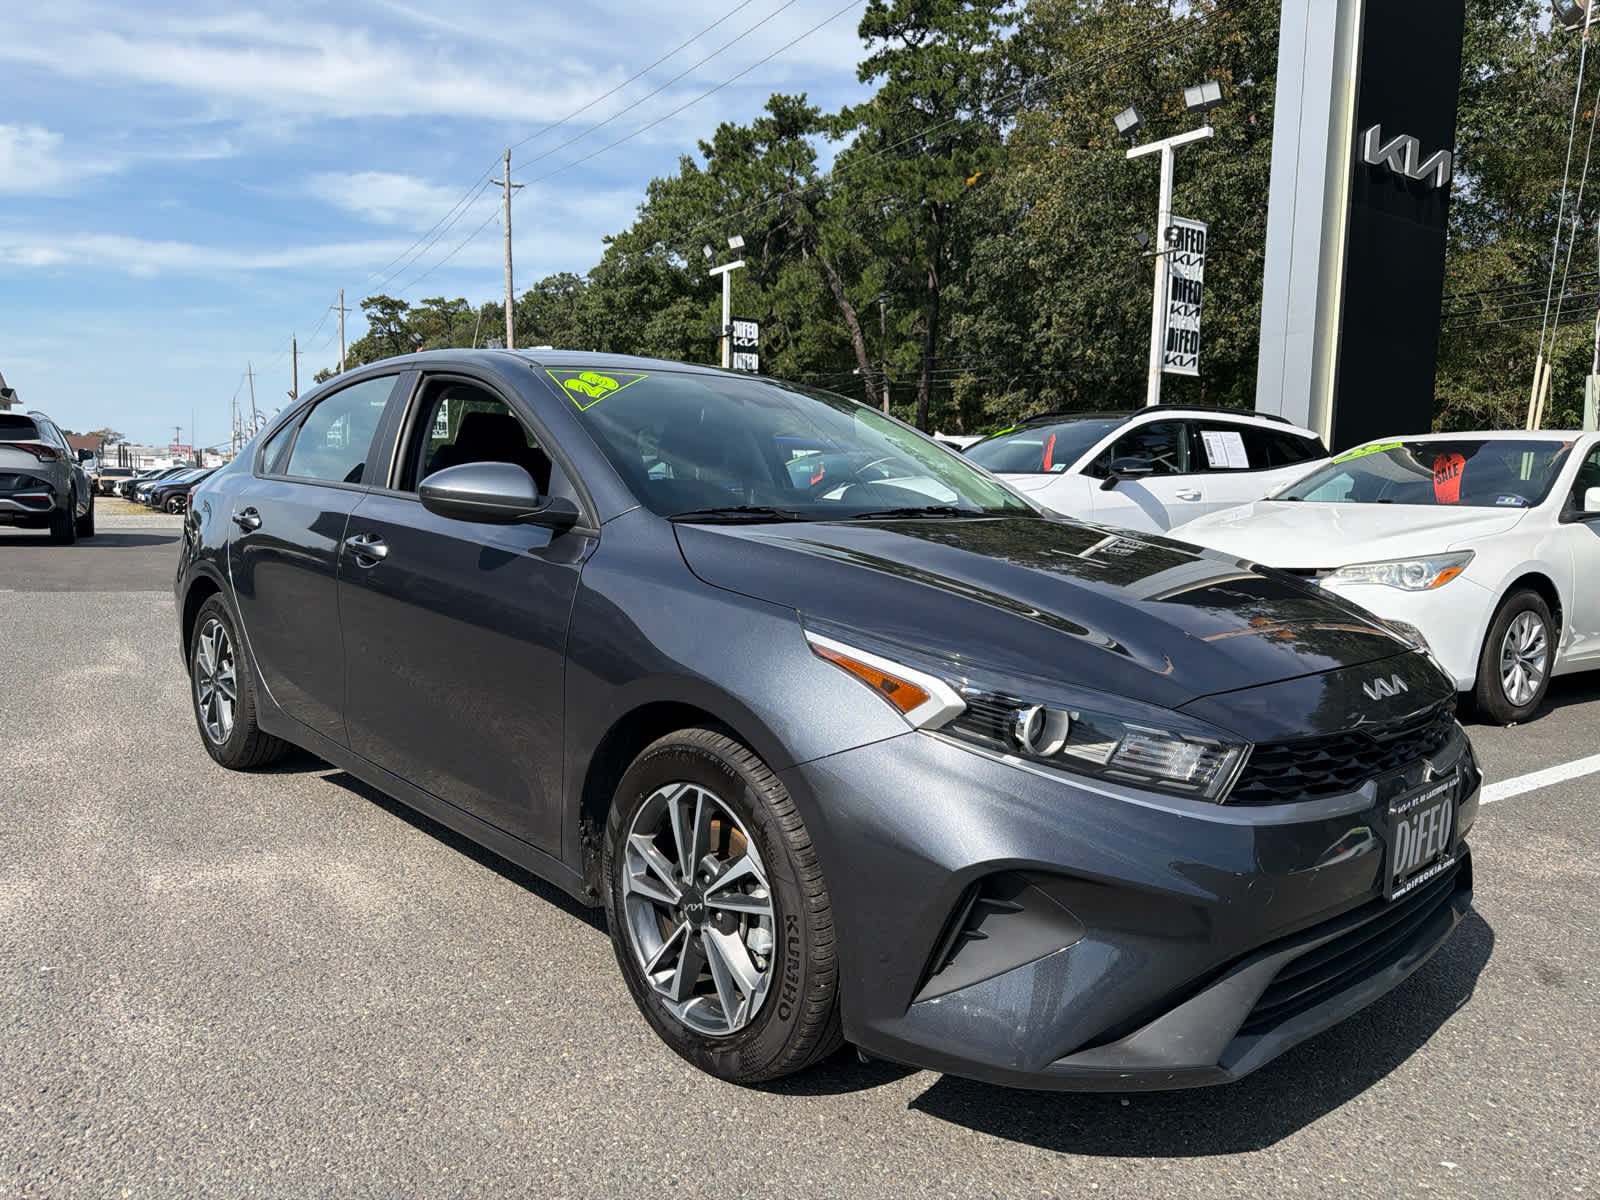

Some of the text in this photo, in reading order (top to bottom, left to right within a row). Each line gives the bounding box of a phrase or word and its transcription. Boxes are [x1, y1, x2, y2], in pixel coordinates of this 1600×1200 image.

[1364, 123, 1452, 188] KIA
[1173, 252, 1204, 266] KIA
[1170, 303, 1201, 317] KIA
[1164, 354, 1197, 367] KIA
[1435, 462, 1460, 485] SALE
[1362, 674, 1409, 701] KIA
[1392, 797, 1453, 876] DiFEO
[777, 914, 800, 1022] KUMHO
